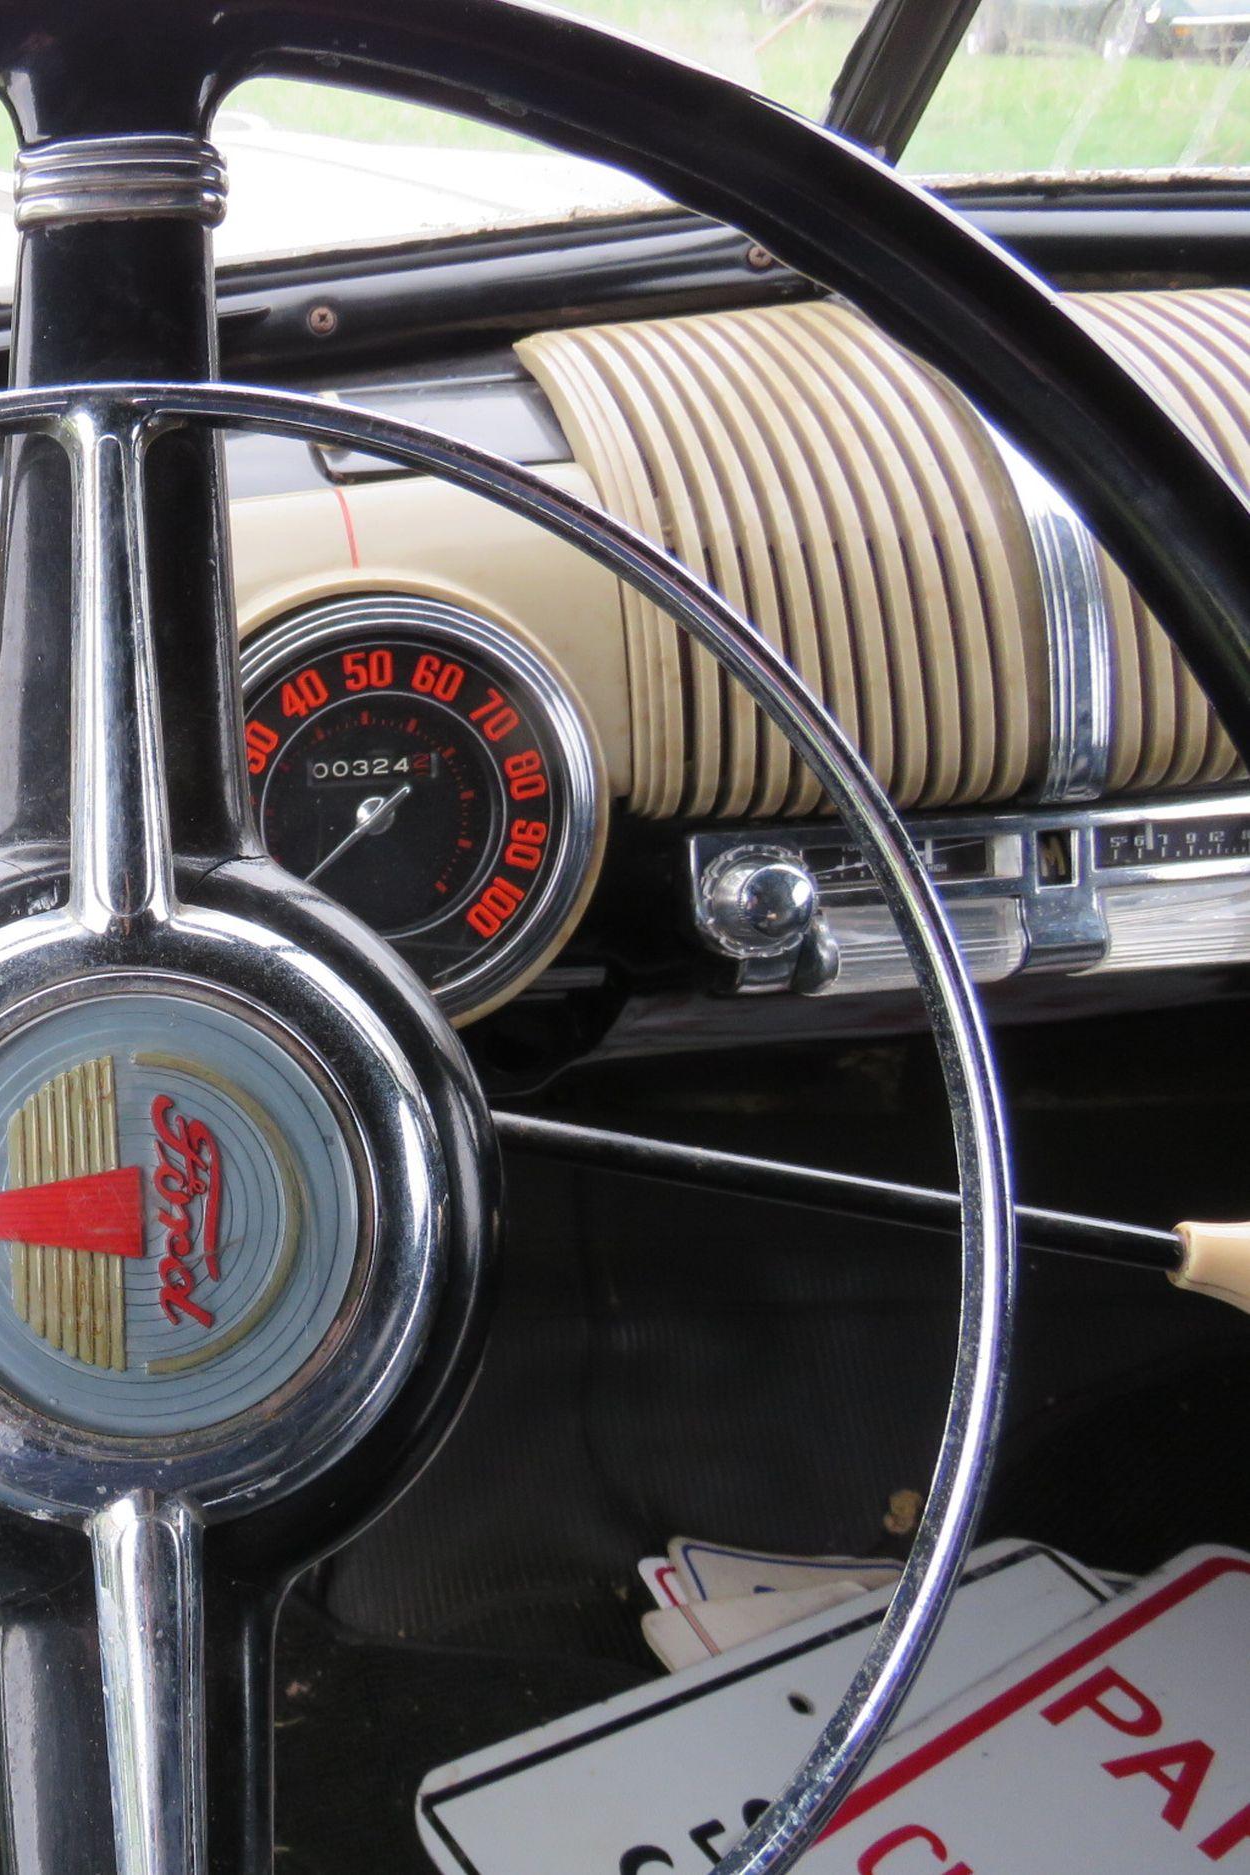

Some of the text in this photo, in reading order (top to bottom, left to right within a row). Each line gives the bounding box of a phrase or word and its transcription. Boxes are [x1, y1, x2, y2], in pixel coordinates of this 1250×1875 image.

[281, 668, 329, 719] 40
[342, 649, 393, 691] 50
[411, 654, 464, 702] 60
[469, 687, 520, 742] 70
[503, 749, 548, 801] 80
[505, 818, 548, 872] 90
[1133, 835, 1146, 847] 6
[465, 875, 526, 939] 100
[150, 1094, 222, 1329] Ford
